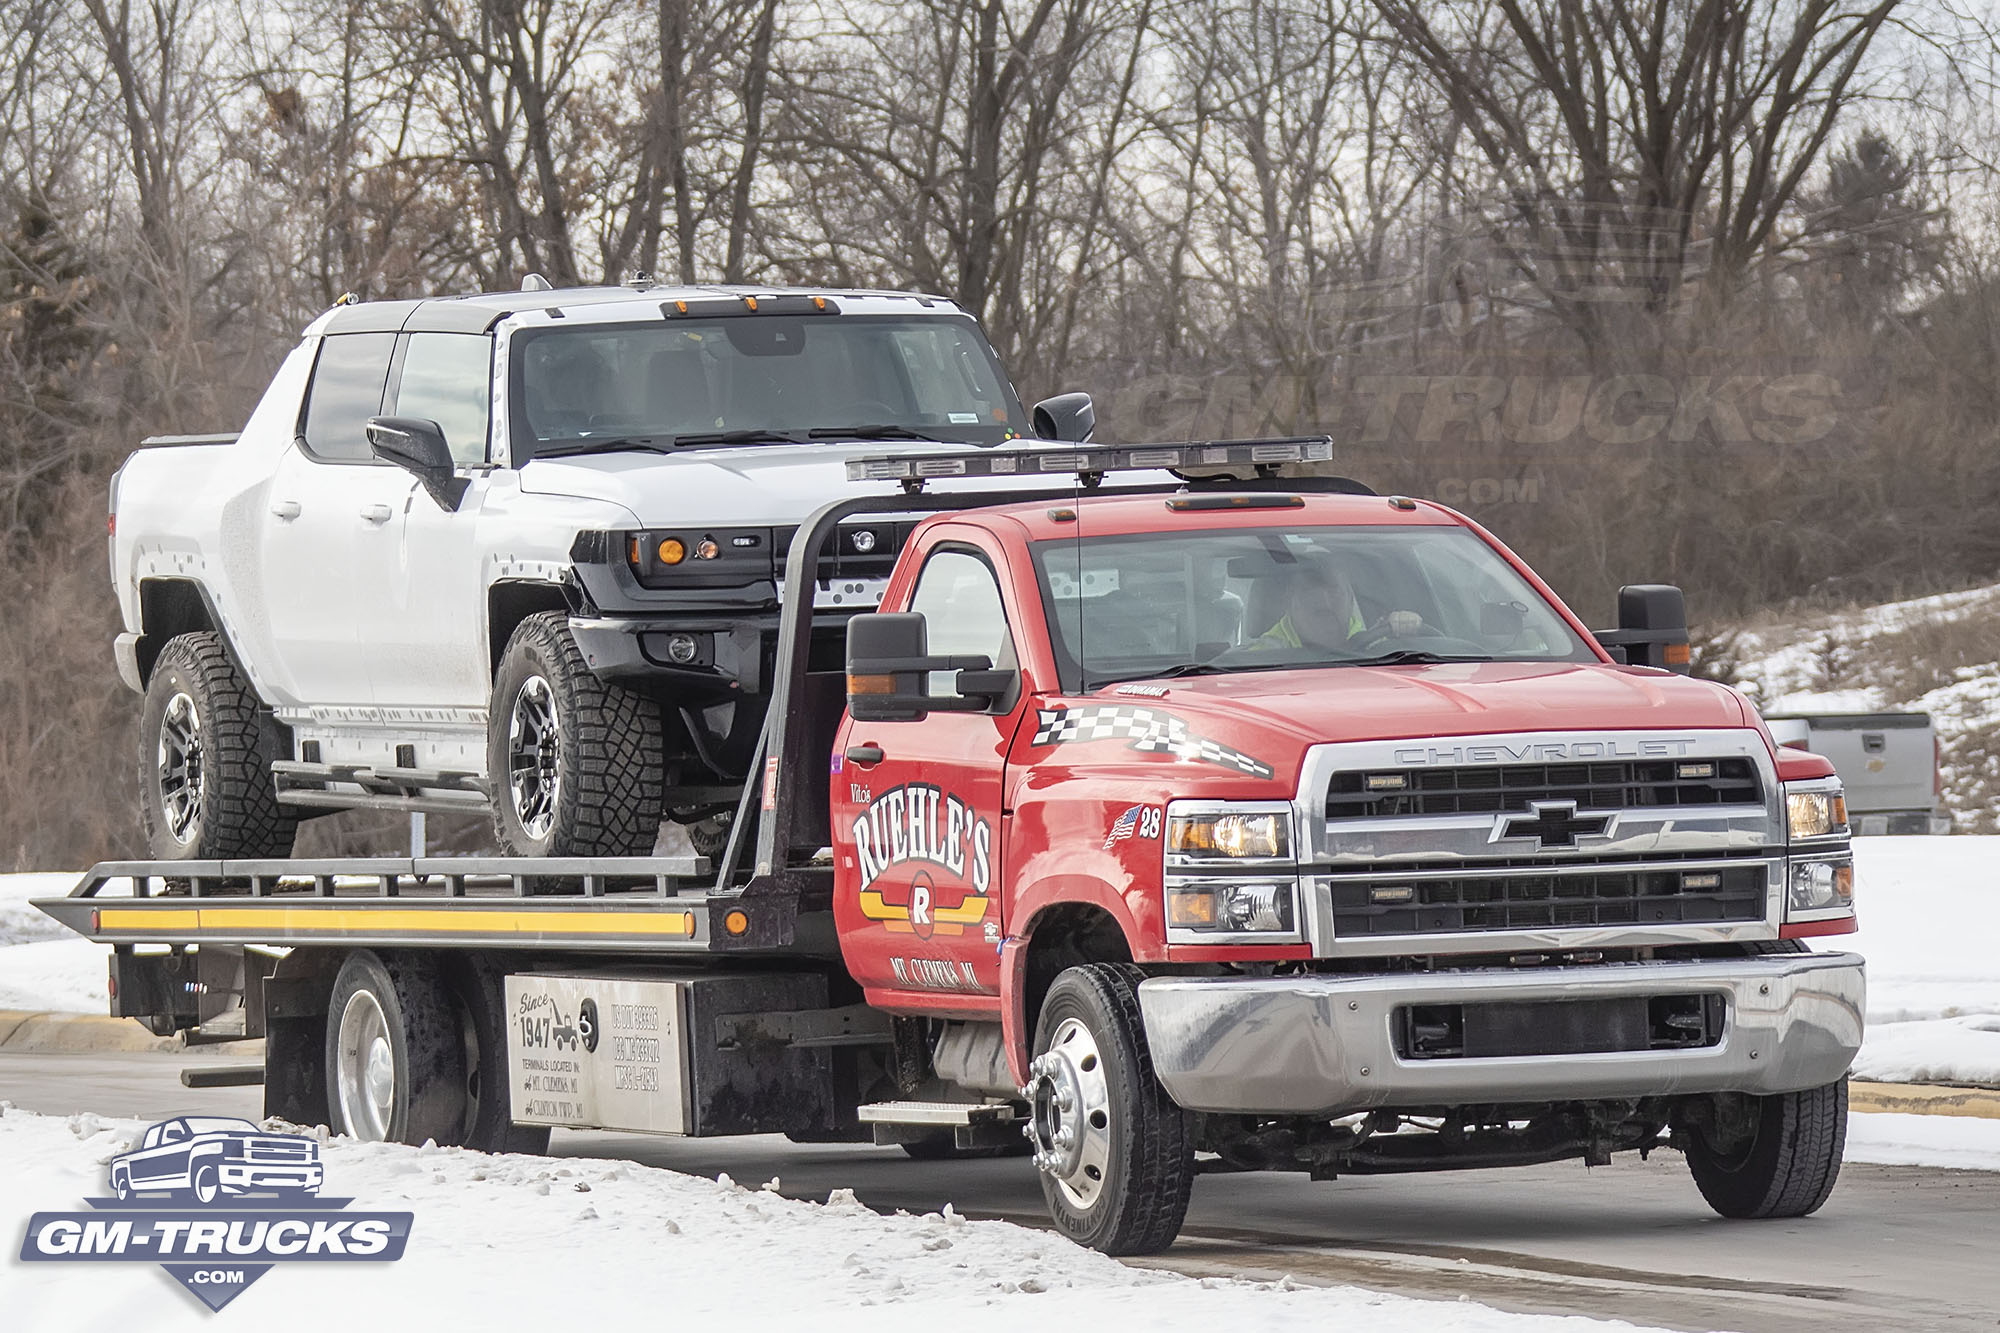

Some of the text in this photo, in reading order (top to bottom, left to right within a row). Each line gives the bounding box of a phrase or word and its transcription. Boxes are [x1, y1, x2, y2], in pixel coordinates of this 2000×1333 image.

[1394, 738, 1697, 765] CHEVROLET
[850, 783, 871, 804] Vito's
[1139, 806, 1161, 839] 28
[852, 784, 990, 894] RUEHLE'S
[913, 886, 930, 925] R
[519, 992, 548, 1014] Since
[520, 1016, 551, 1049] 1947
[522, 1058, 549, 1072] TERMINALS
[550, 1060, 572, 1073] LOCATED
[533, 1099, 557, 1117] CLINTON
